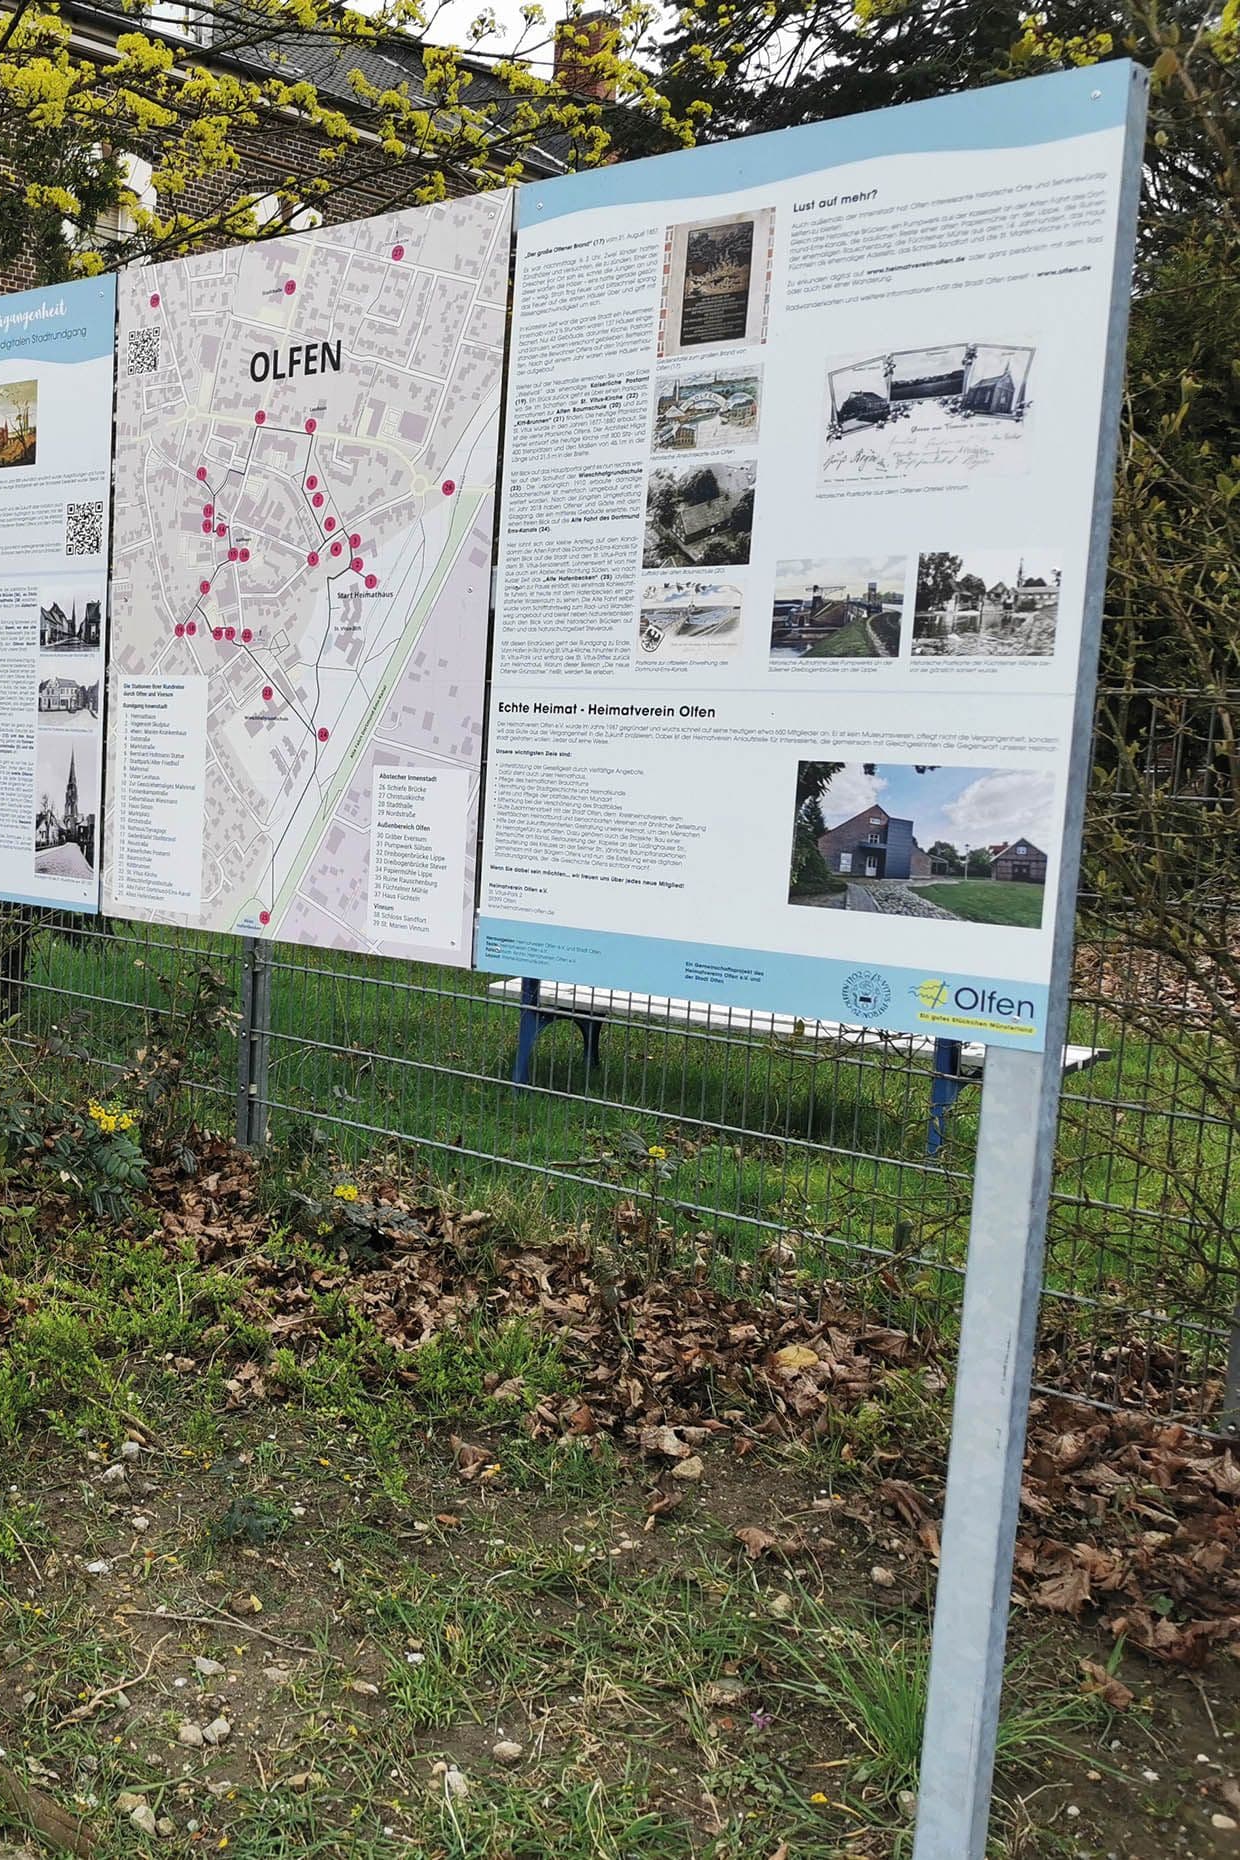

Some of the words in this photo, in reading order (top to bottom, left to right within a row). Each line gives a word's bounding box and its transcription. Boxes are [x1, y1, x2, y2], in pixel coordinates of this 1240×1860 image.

[792, 199, 815, 213] Lust
[818, 195, 837, 208] auf
[840, 188, 878, 205] mehr?
[0, 335, 31, 353] digitalen
[31, 326, 87, 347] Stadtrundgang
[249, 338, 342, 383] OLFEN
[354, 590, 393, 598] Heimathaus
[498, 701, 529, 713] Echte
[533, 702, 577, 714] Heimat
[587, 703, 675, 718] Heimatverein
[679, 705, 716, 718] Olfen
[954, 987, 1034, 1019] Olfen
